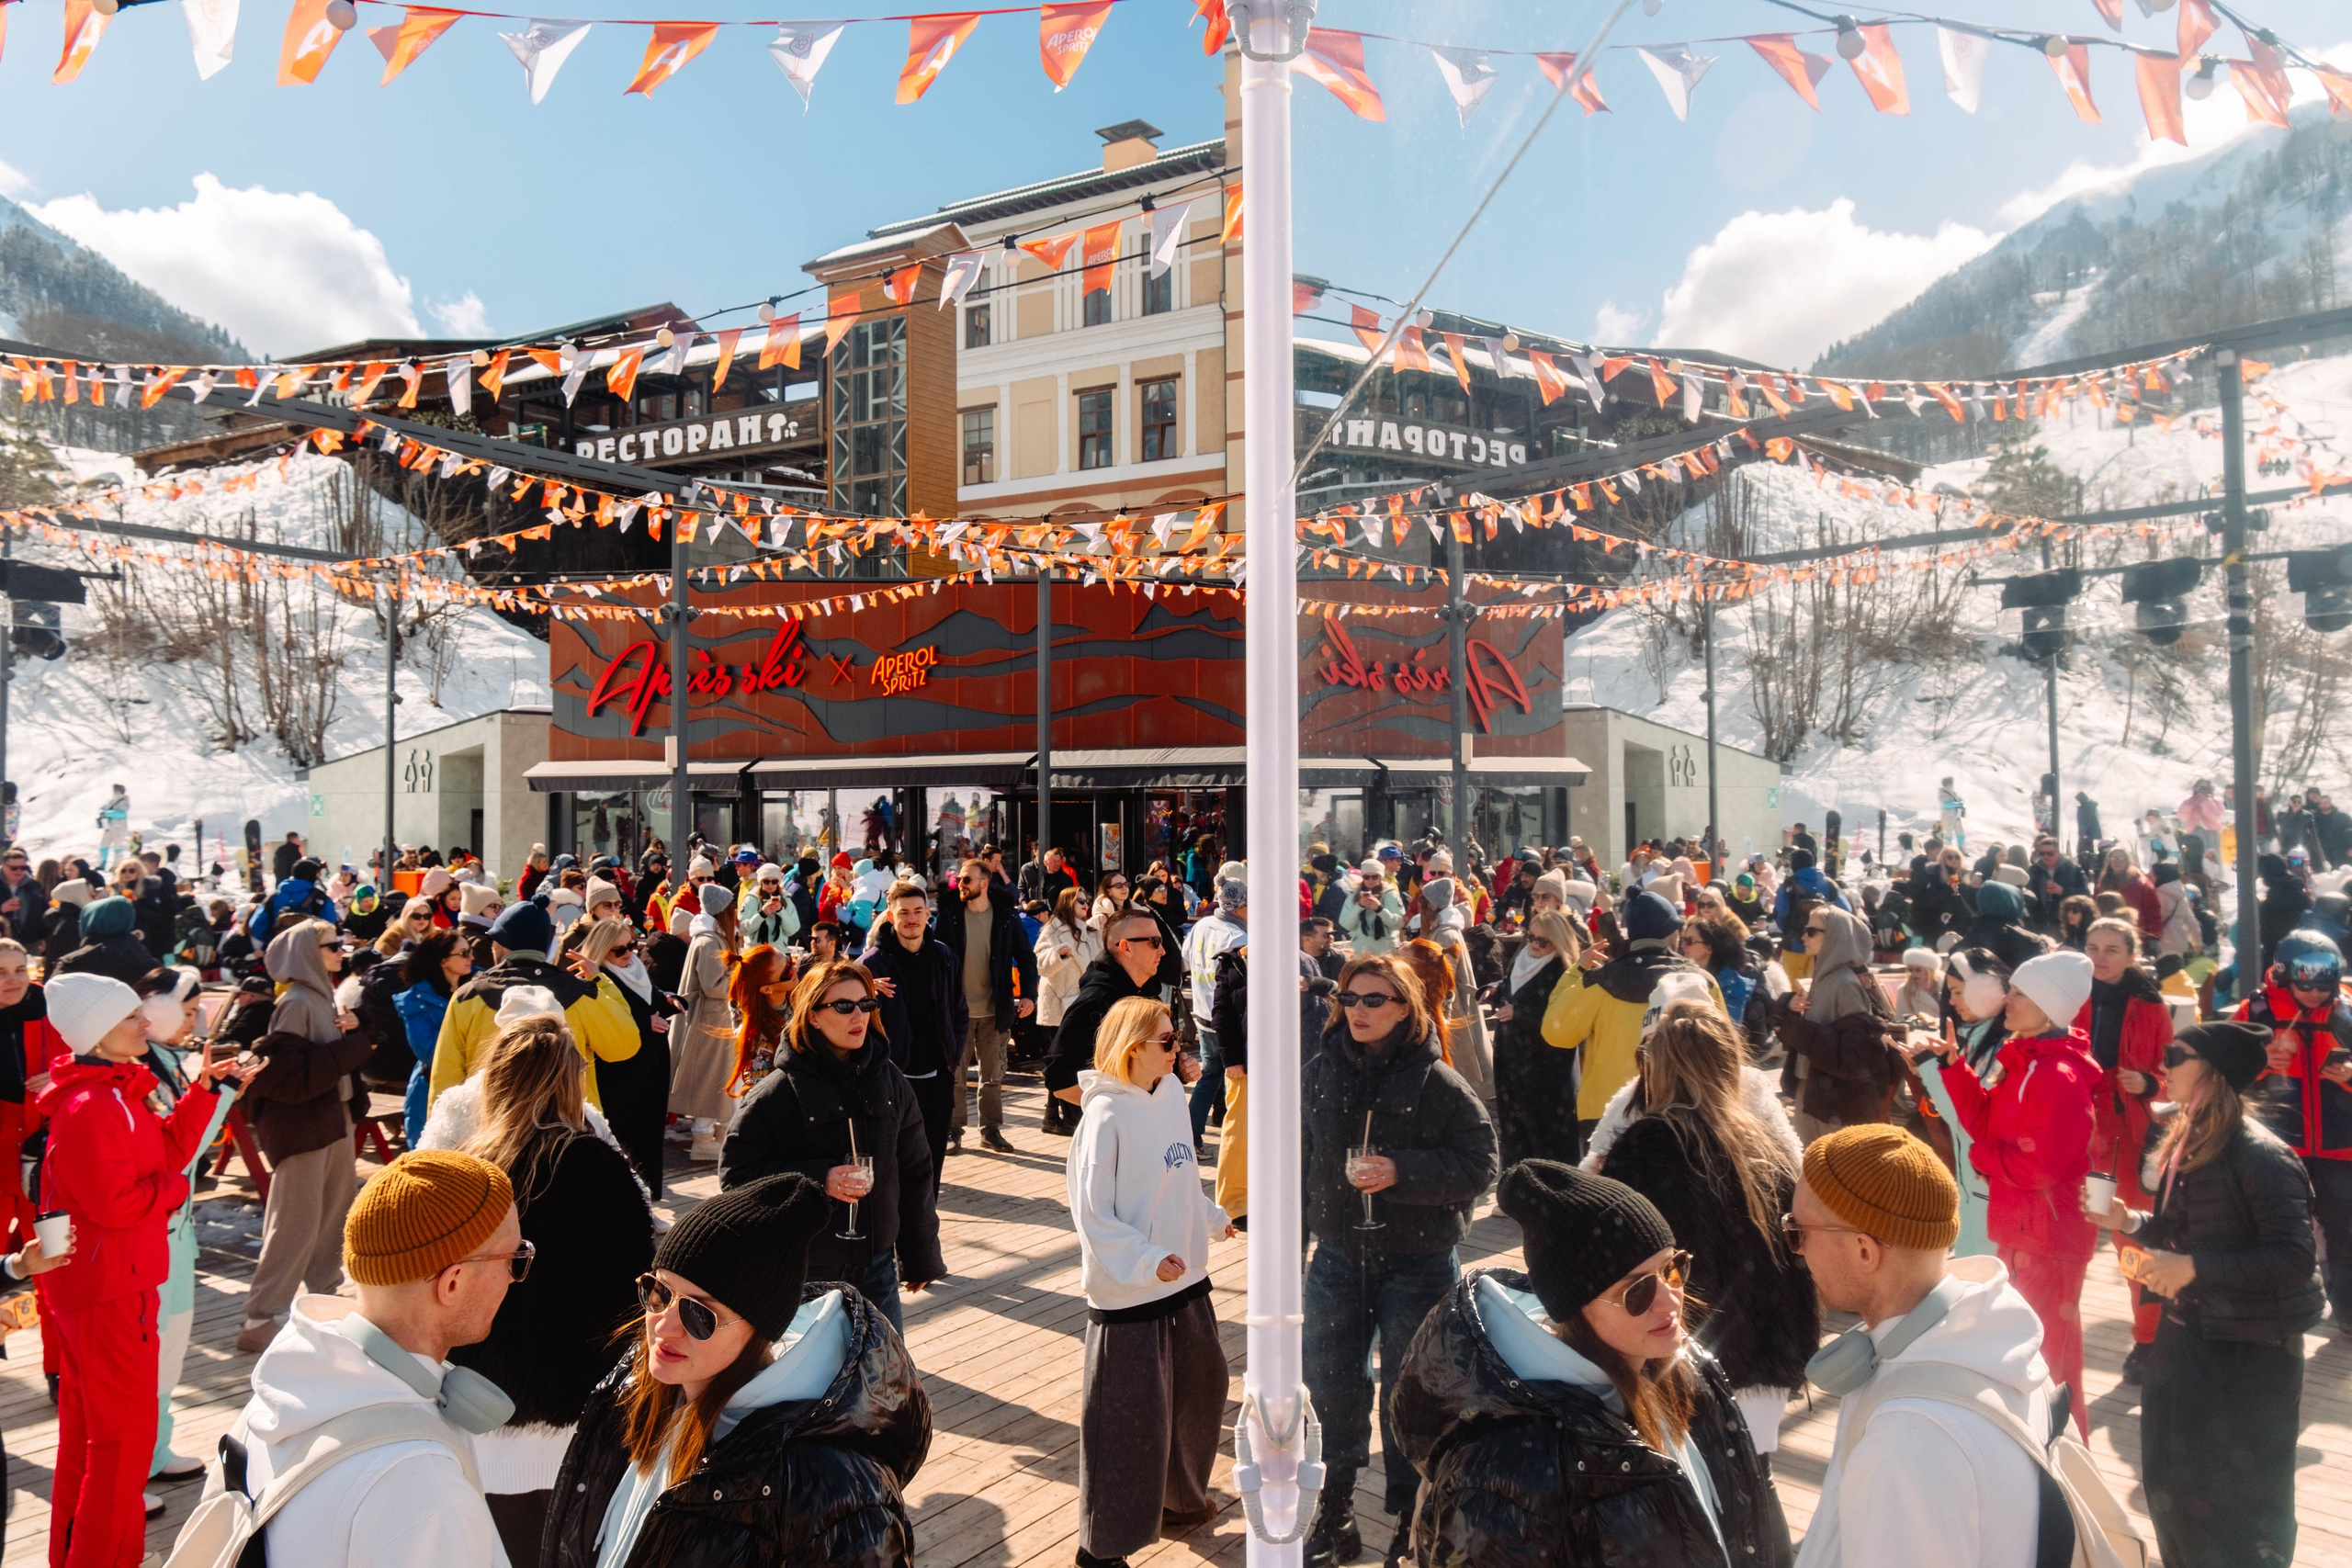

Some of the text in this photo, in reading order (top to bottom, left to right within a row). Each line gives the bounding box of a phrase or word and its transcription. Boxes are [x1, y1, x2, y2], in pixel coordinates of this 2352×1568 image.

[1087, 245, 1116, 267] APEROL
[586, 641, 732, 737] Apès
[741, 616, 806, 694] ski
[870, 644, 939, 685] APEROL
